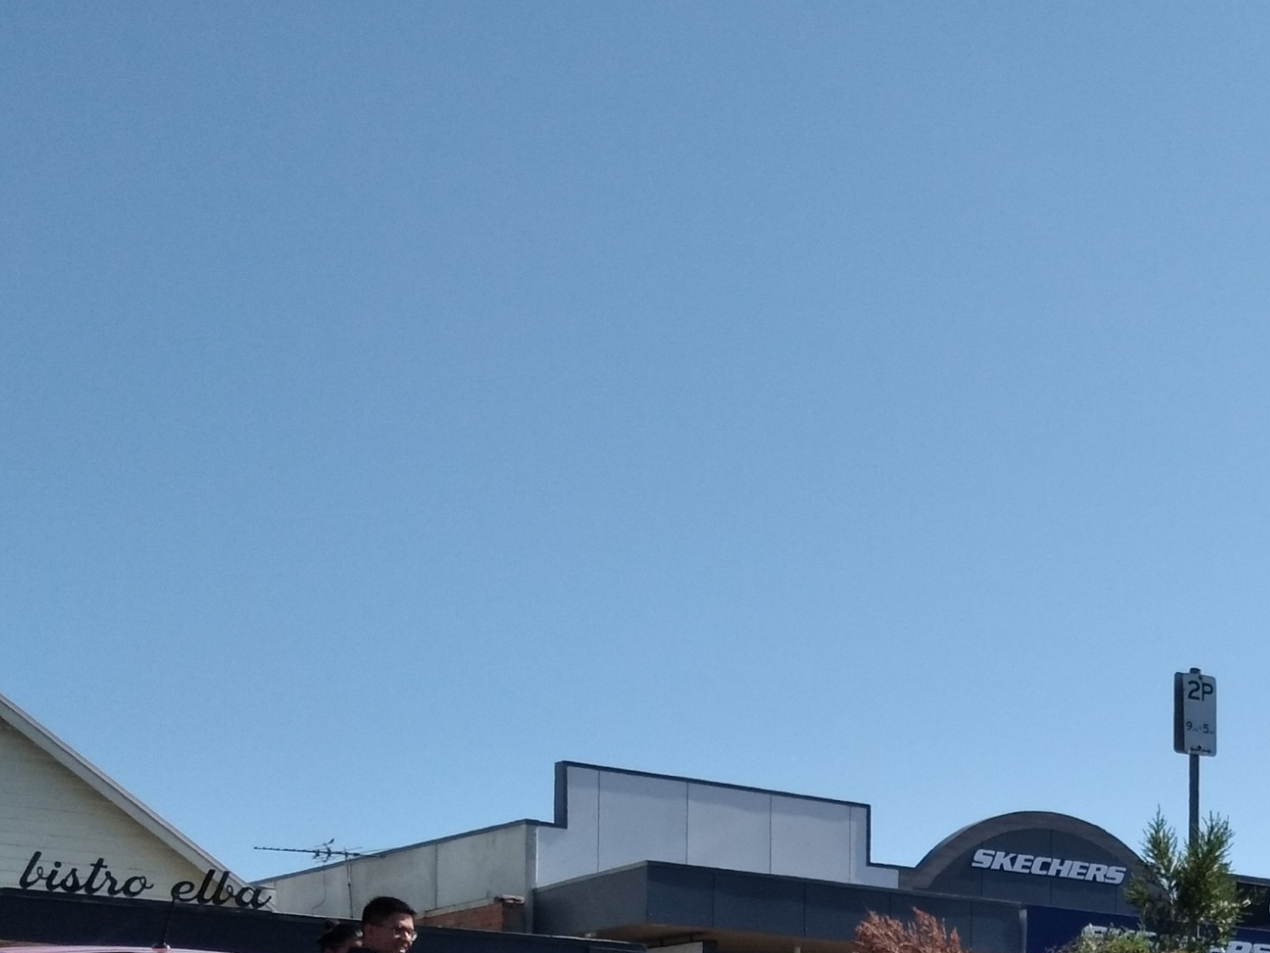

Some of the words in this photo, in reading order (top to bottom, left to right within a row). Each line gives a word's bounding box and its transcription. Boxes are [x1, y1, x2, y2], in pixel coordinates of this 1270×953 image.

[1188, 681, 1214, 701] 2P
[18, 850, 154, 897] bistro
[170, 869, 272, 908] elba
[971, 849, 1127, 885] SKECHERS
